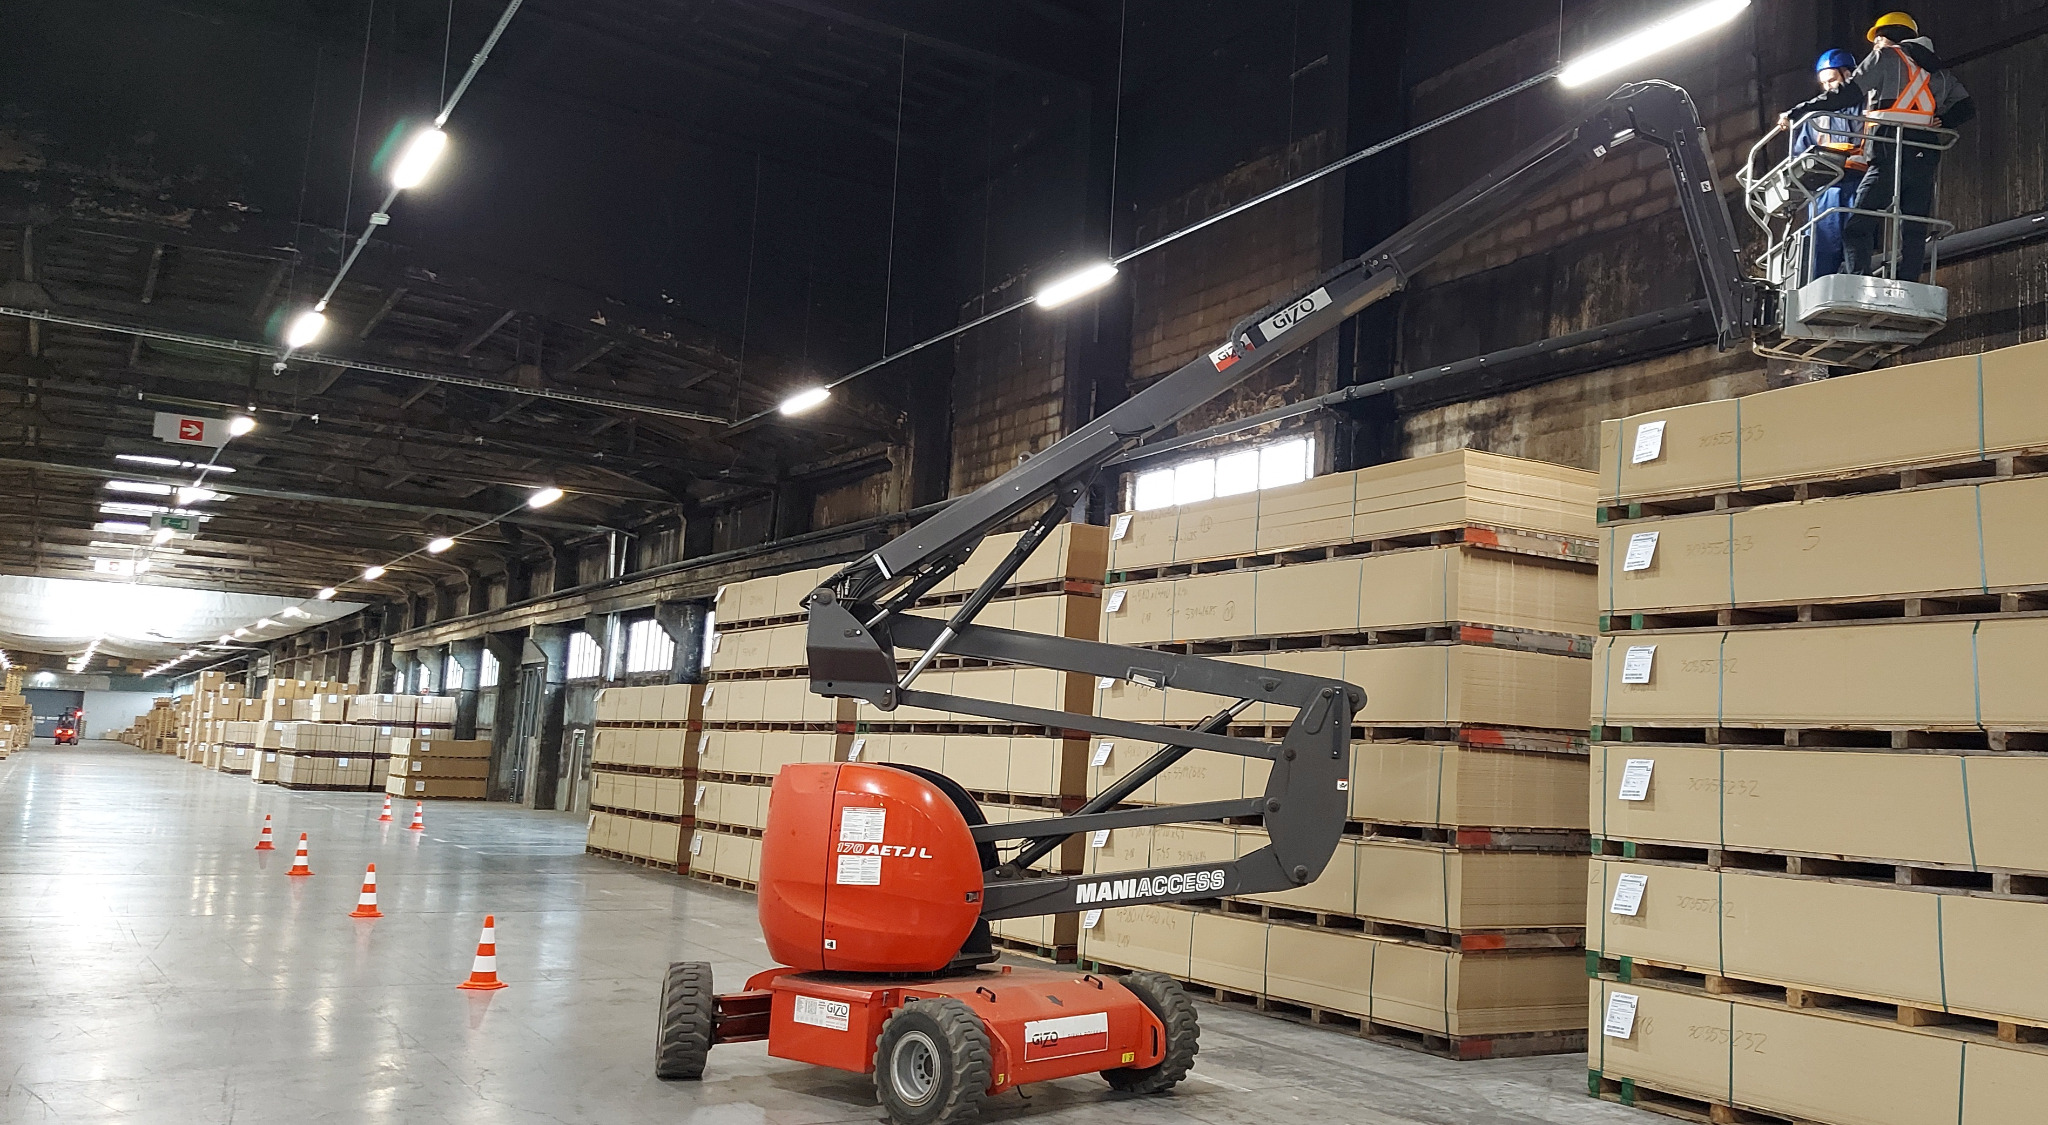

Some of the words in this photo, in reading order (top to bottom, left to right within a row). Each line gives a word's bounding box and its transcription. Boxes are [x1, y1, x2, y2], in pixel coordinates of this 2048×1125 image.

[1801, 526, 1822, 552] 5
[837, 842, 865, 854] 170
[1076, 869, 1226, 904] MANIACCESS
